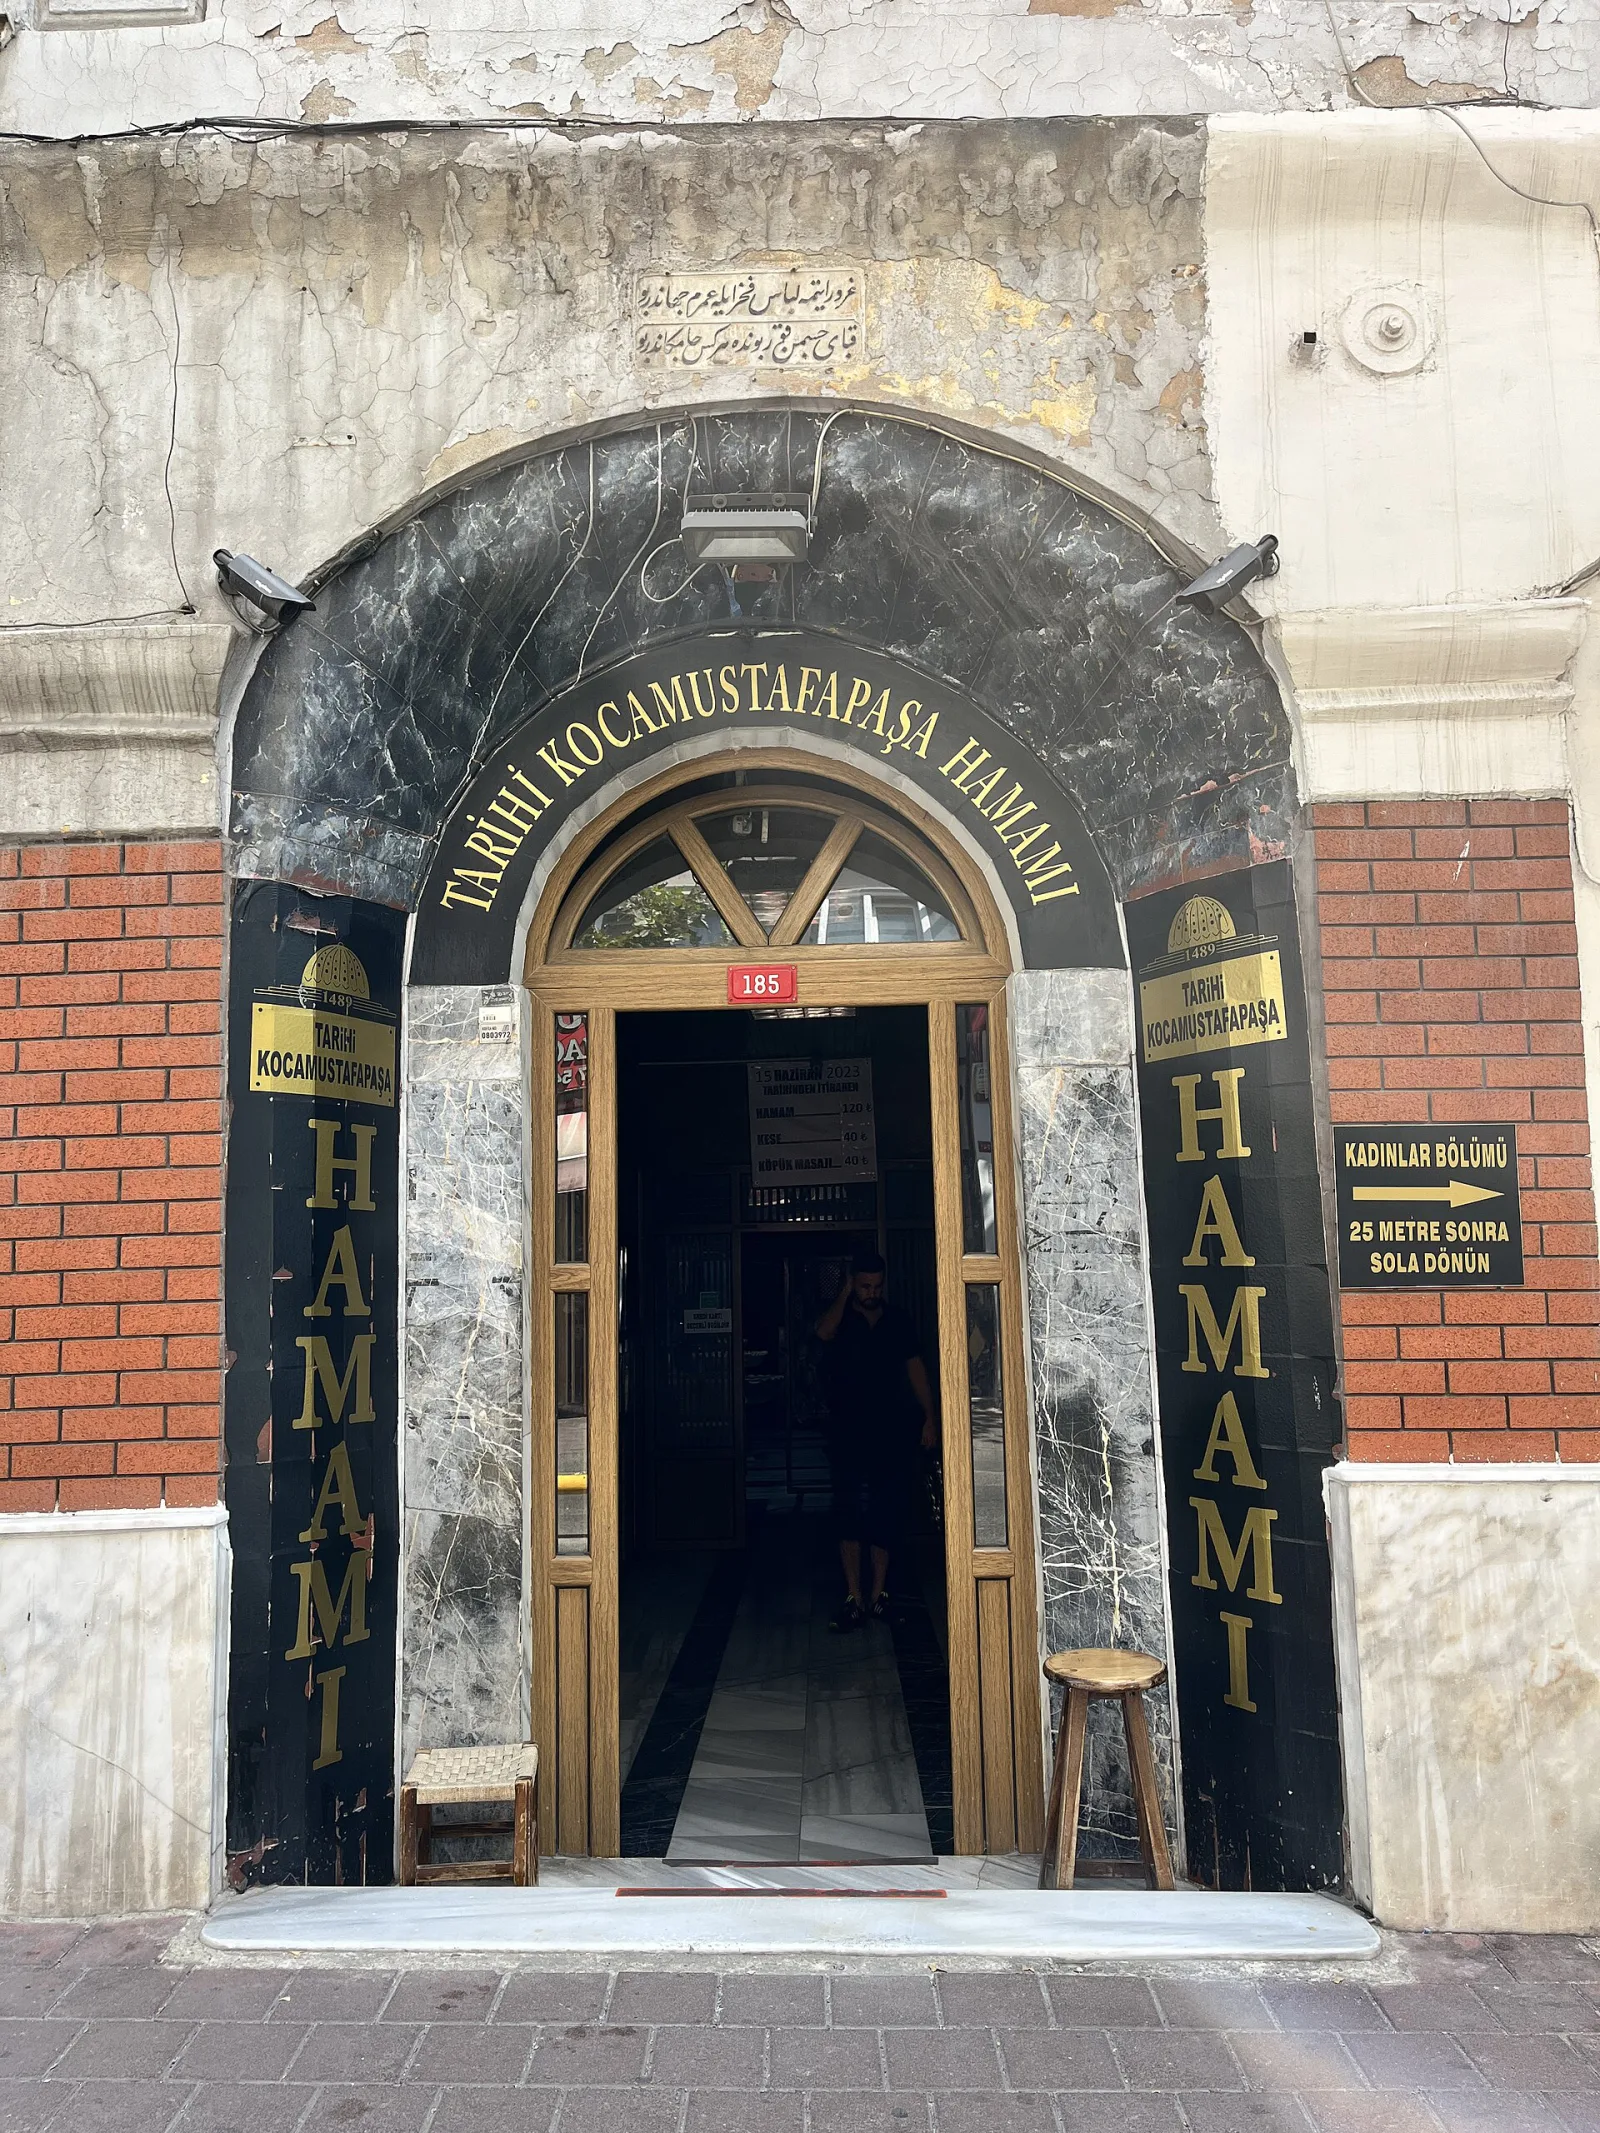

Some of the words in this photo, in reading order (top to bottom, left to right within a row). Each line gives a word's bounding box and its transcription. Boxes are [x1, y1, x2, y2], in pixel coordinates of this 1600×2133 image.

[440, 763, 555, 912] TARİHİ
[535, 661, 940, 788] KOCAMUSTAFAPAŞA
[937, 736, 1081, 907] HAMAMI
[1184, 942, 1216, 962] 1489
[742, 974, 780, 996] 185
[321, 991, 354, 1009] 1489
[1147, 998, 1280, 1049] KOCAMUSTAFAPAŞA
[256, 1050, 392, 1098] KOCAMUSTAFAPAŞA
[827, 1066, 860, 1079] 2023
[756, 1106, 795, 1119] HAMAM
[842, 1103, 863, 1114] 120
[757, 1133, 782, 1146] KESE
[843, 1132, 858, 1142] 40
[1345, 1142, 1429, 1168] KADINLAR
[1435, 1136, 1508, 1168] BÖLÜMÜ
[758, 1157, 794, 1172] KÖPÜK
[844, 1156, 859, 1166] 40
[1349, 1221, 1374, 1242] 25
[1379, 1220, 1440, 1242] METRE
[1445, 1220, 1510, 1242] SONRA
[1370, 1252, 1420, 1274] SOLA
[1424, 1247, 1490, 1274] DÖNÜN
[1171, 1066, 1283, 1714] HAMAMI
[284, 1117, 377, 1771] HAMAMI
